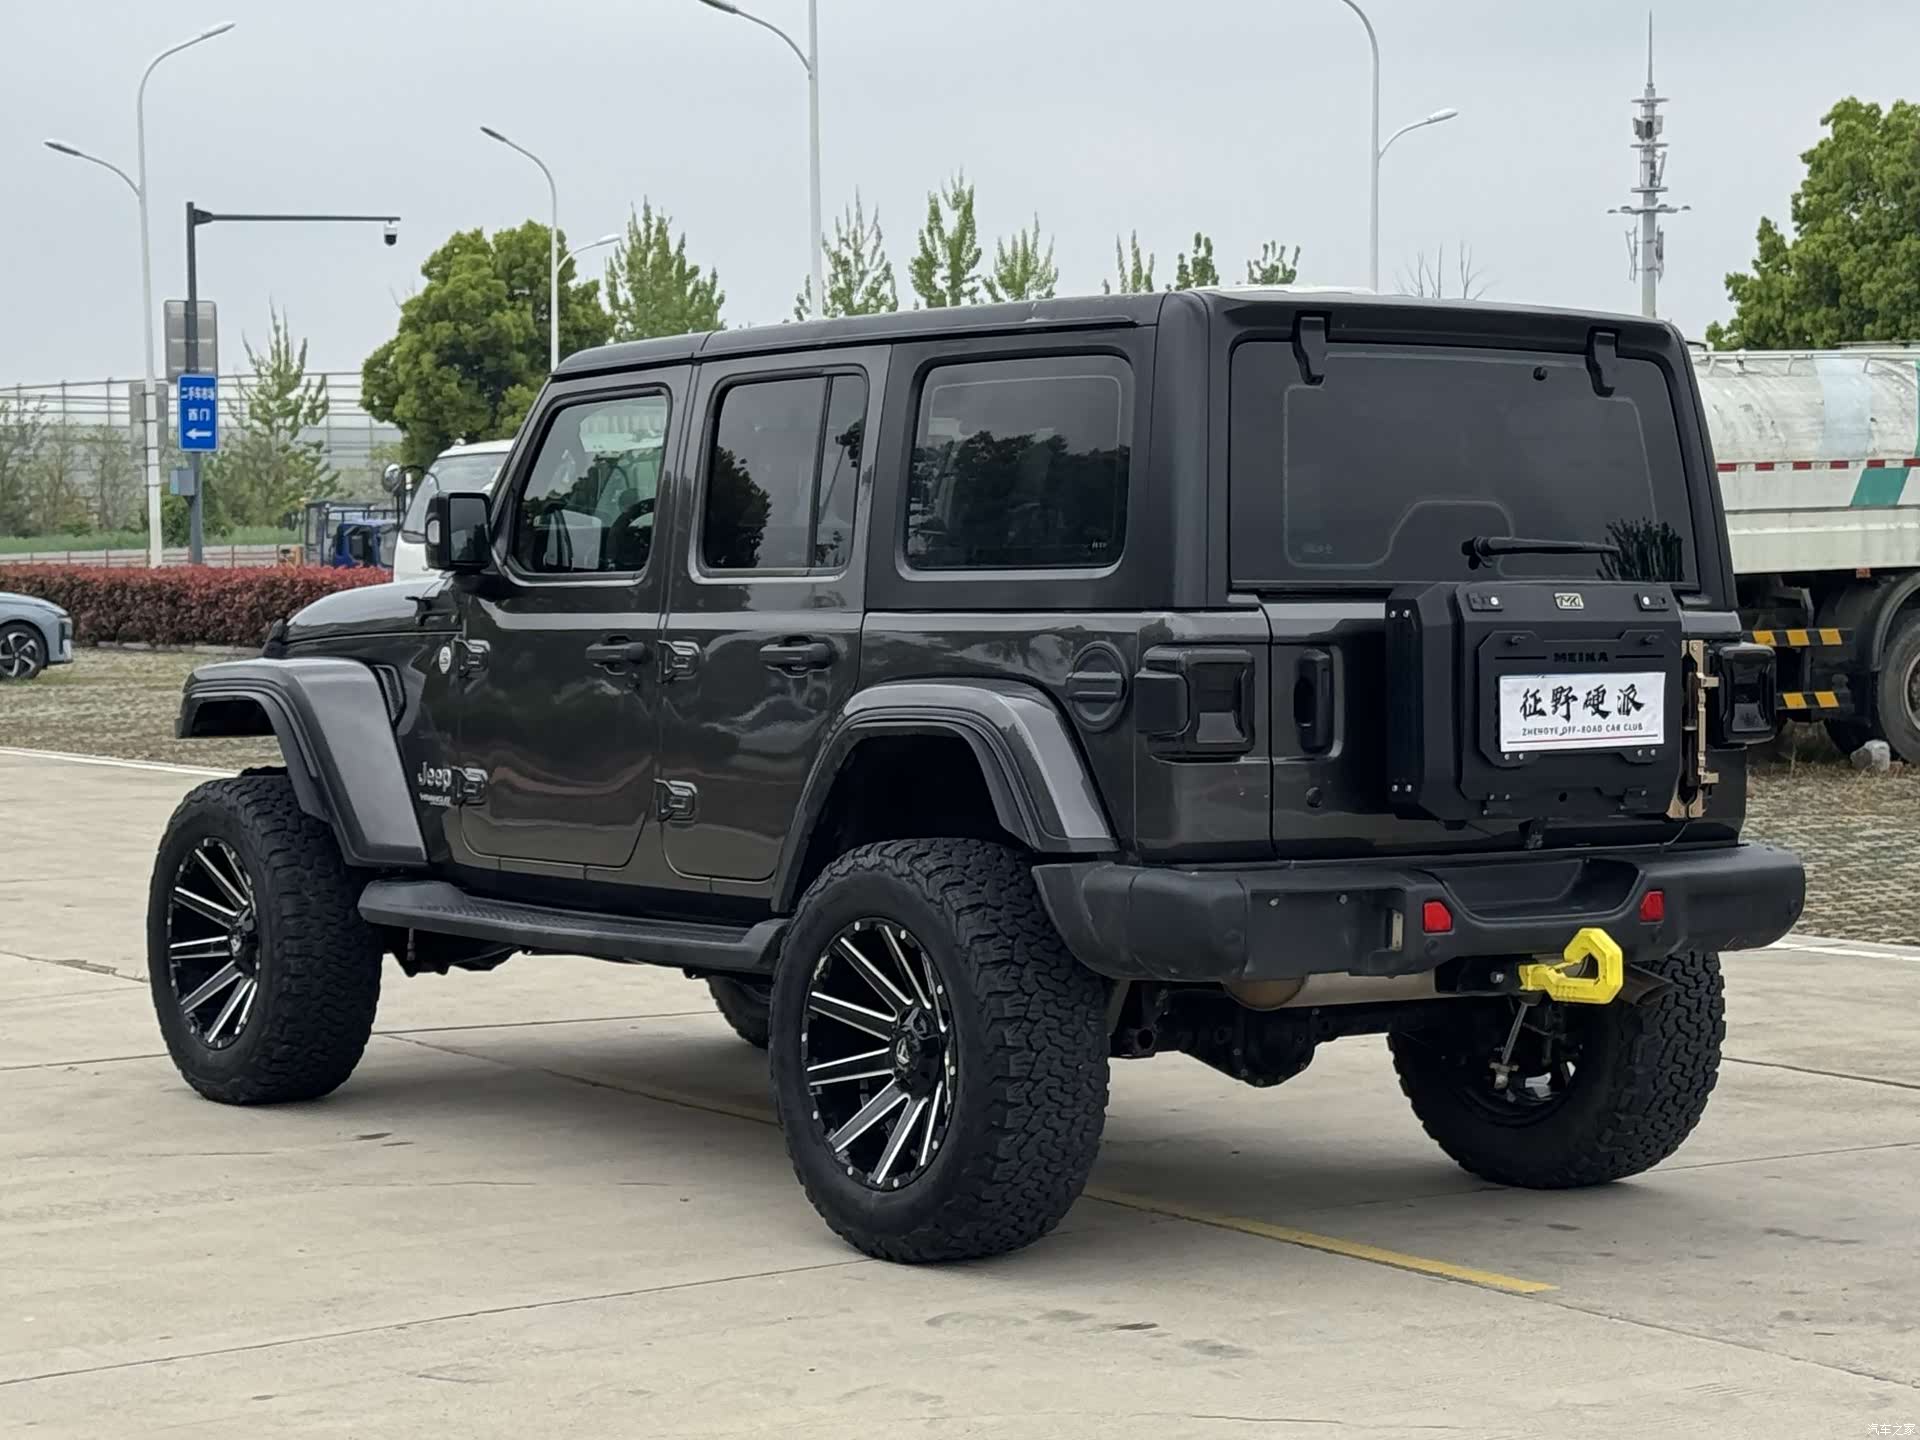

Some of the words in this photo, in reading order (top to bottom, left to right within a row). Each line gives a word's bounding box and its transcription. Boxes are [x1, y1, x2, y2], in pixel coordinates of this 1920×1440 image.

[1553, 652, 1609, 663] MEIKA
[1519, 683, 1645, 723] 征野硬派
[1561, 725, 1603, 736] OFF-ROAD
[1605, 723, 1621, 733] CAR
[1623, 722, 1644, 731] CLUB
[417, 761, 452, 792] Jeep
